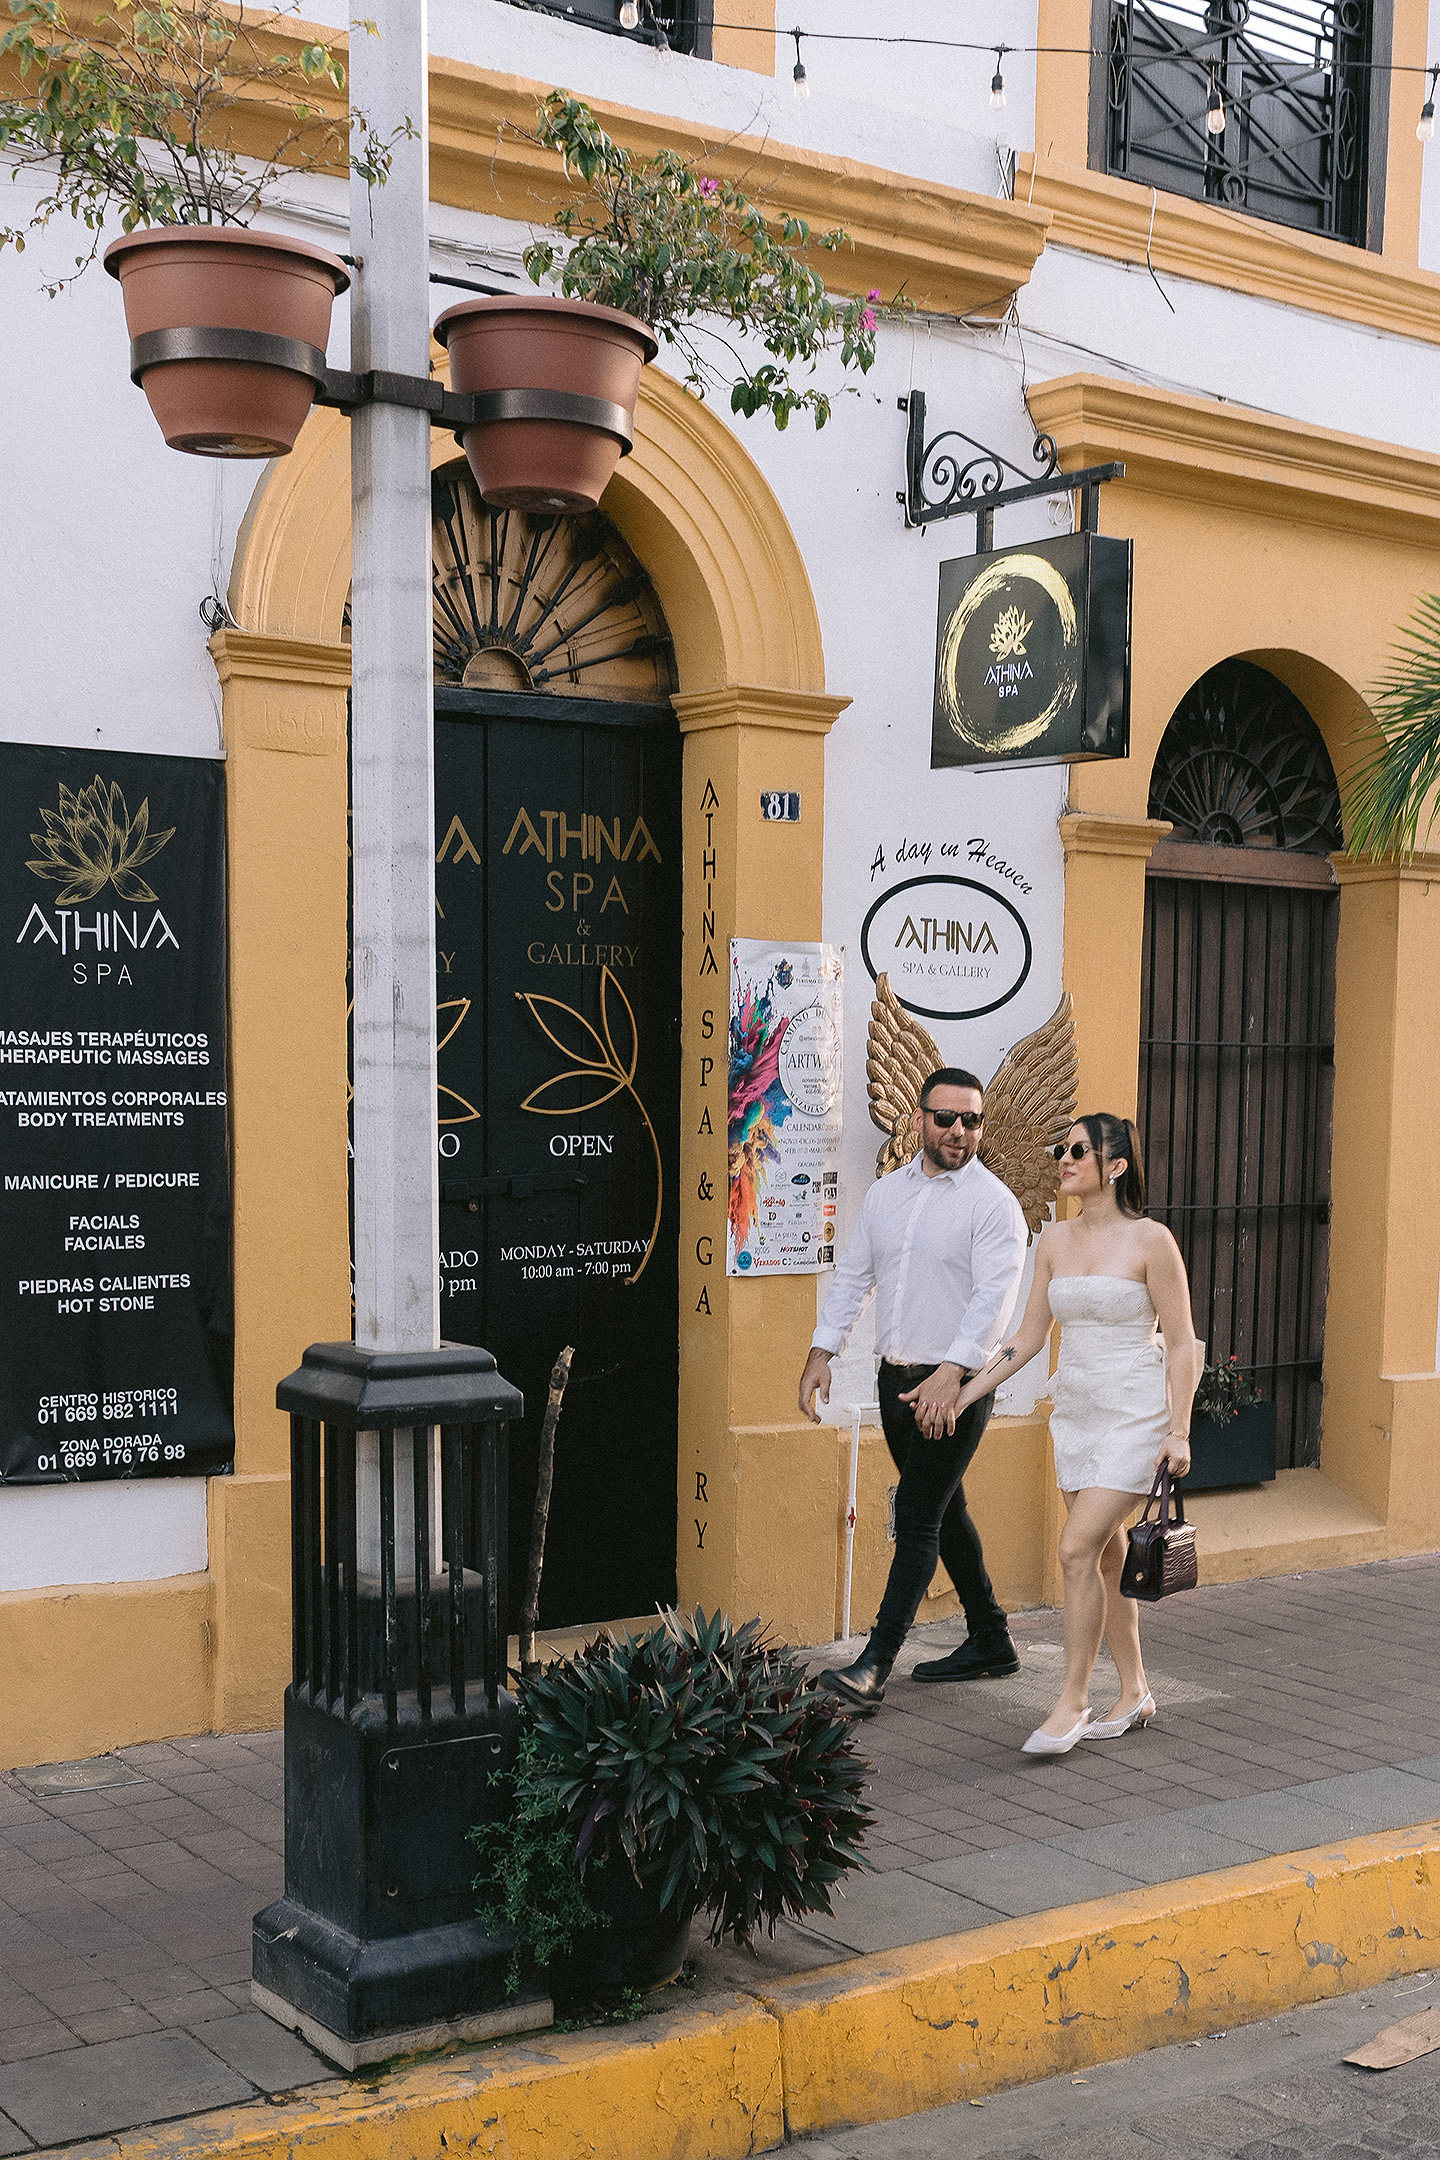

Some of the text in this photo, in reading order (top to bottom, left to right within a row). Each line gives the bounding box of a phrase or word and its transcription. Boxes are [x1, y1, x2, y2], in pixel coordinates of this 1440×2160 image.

[984, 660, 1034, 686] ATHINA
[998, 684, 1019, 697] SPA
[767, 792, 790, 820] 81
[502, 806, 662, 864] ATHINA
[700, 778, 719, 976] ATHINA
[870, 838, 1033, 895] A day in Heaven
[545, 870, 629, 914] SPA
[16, 902, 180, 955] ATHINA
[576, 918, 591, 936] &
[894, 914, 1000, 955] ATHINA
[527, 942, 639, 968] GALLERY
[73, 962, 133, 985] SPA
[902, 961, 992, 979] SPA & GALLERY
[77, 1029, 208, 1047] TERAPÉUTICOS
[0, 1048, 210, 1065] HERAPEUTIC MASSAGES
[0, 1091, 228, 1106] ATAMIENTOS CORPORALES
[18, 1112, 184, 1127] BODY TREATMENTS
[549, 1134, 614, 1157] OPEN
[4, 1173, 200, 1190] MANICURE / PEDICURE
[697, 1171, 714, 1201] &
[69, 1214, 140, 1230] FACIALS
[64, 1235, 145, 1251] FACIALES
[500, 1245, 566, 1262] MONDAY
[576, 1239, 651, 1257] SATURDAY
[521, 1265, 552, 1280] 10:00
[555, 1264, 574, 1277] am
[585, 1262, 608, 1276] 7:00
[612, 1261, 631, 1278] pm
[18, 1273, 191, 1295] PIEDRAS CALIENTES
[448, 1277, 478, 1297] pm
[57, 1296, 155, 1314] HOT STONE
[39, 1387, 177, 1408] CENTRO HISTORICO
[37, 1400, 179, 1424] 01 669 982 1111
[59, 1433, 163, 1453] ZONA DORADA
[37, 1444, 186, 1471] 01 669 176 76 98
